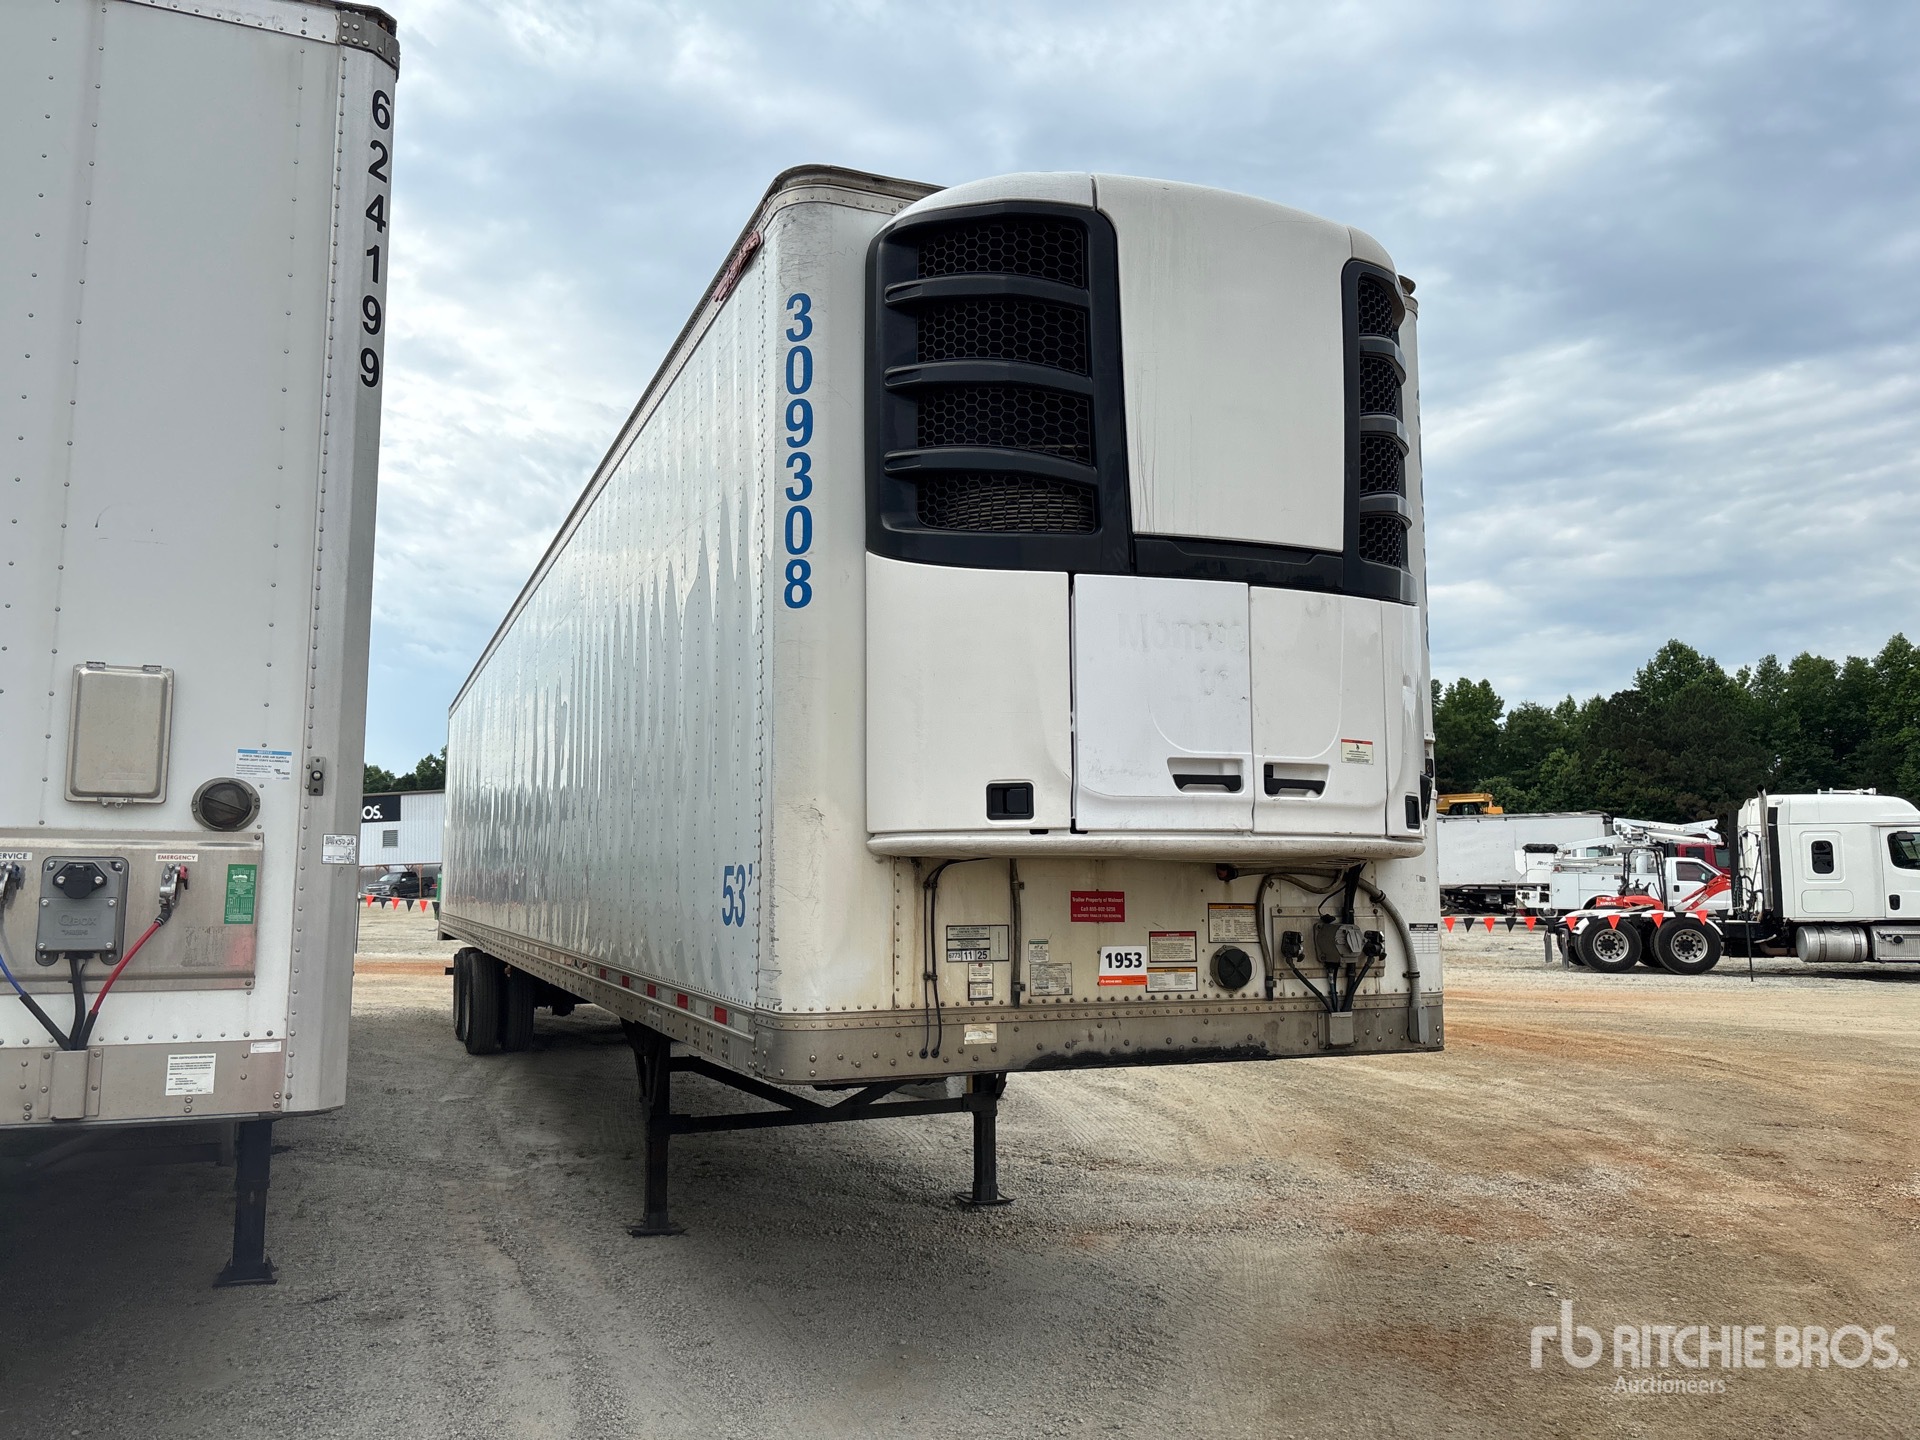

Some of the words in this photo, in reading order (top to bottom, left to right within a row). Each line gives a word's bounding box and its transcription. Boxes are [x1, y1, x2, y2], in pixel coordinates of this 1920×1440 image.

[360, 89, 391, 388] 624199
[783, 292, 813, 609] 309308
[721, 863, 753, 928] 53'
[964, 951, 973, 960] 11
[977, 951, 988, 960] 25
[1105, 952, 1143, 969] 1953
